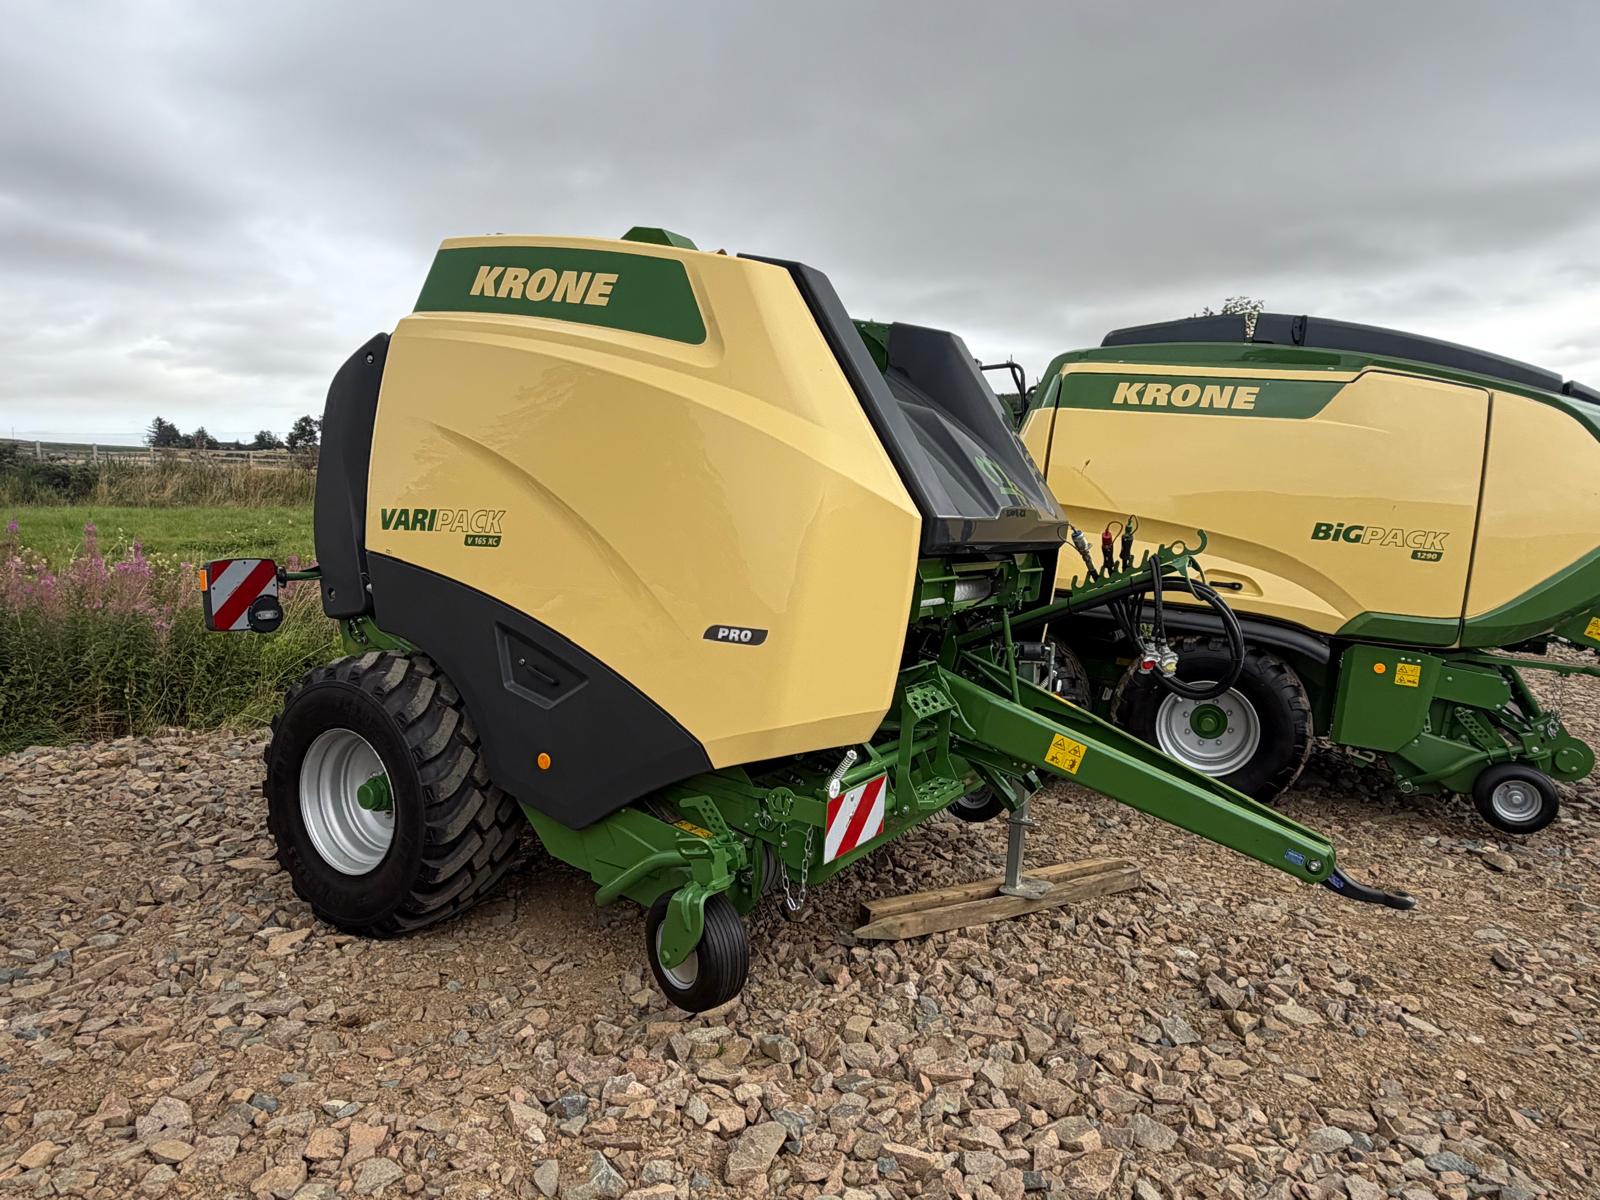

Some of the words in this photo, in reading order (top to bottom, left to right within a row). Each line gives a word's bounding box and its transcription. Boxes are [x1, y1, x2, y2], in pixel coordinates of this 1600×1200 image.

[470, 265, 619, 306] KRONE
[1112, 382, 1260, 410] KRONE
[380, 508, 507, 534] VARIPACK
[467, 536, 474, 545] V
[474, 536, 487, 546] 165
[487, 537, 499, 546] XC
[1415, 551, 1438, 560] 1290
[717, 627, 753, 642] PRO
